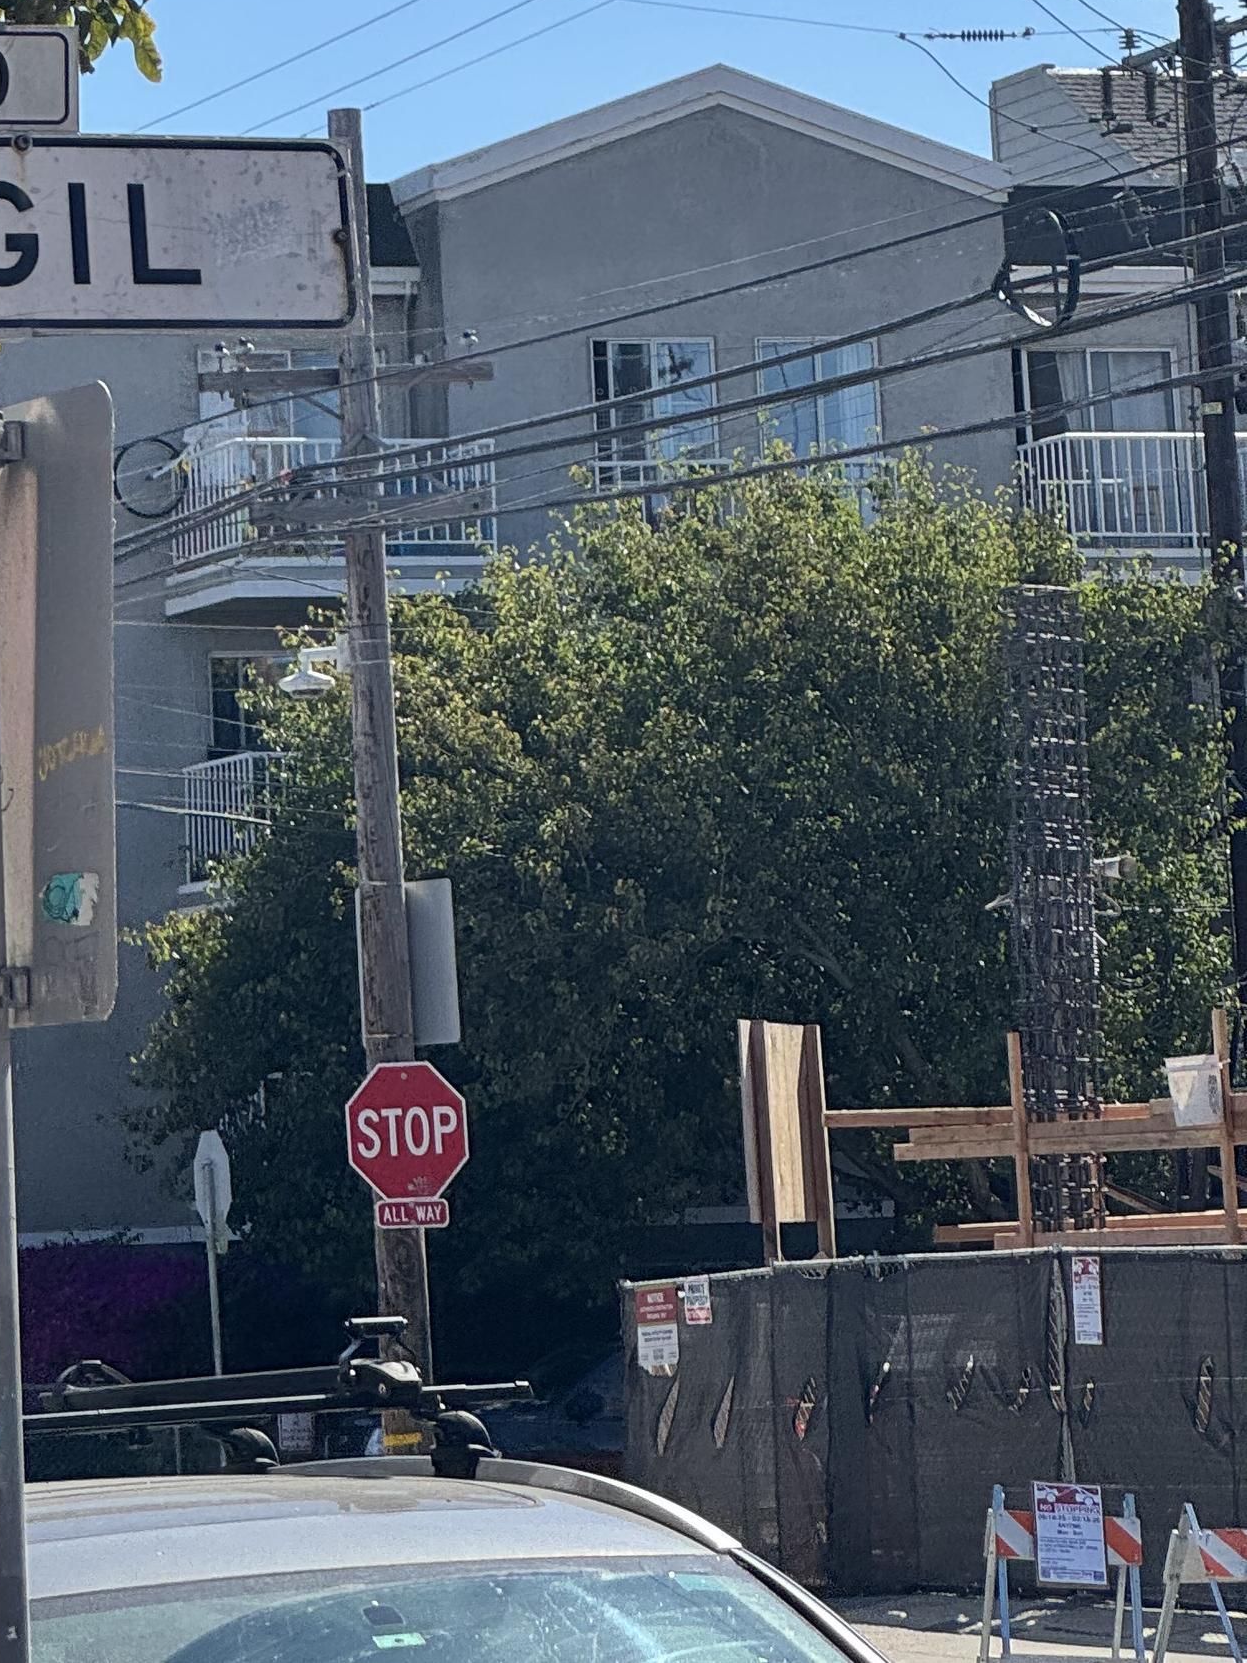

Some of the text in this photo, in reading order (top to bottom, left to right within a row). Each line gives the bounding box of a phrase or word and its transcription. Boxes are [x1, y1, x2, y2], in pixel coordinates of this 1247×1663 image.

[357, 1106, 457, 1158] STOP
[383, 1204, 443, 1223] ALL WAY
[1056, 1504, 1100, 1515] STOPPING
